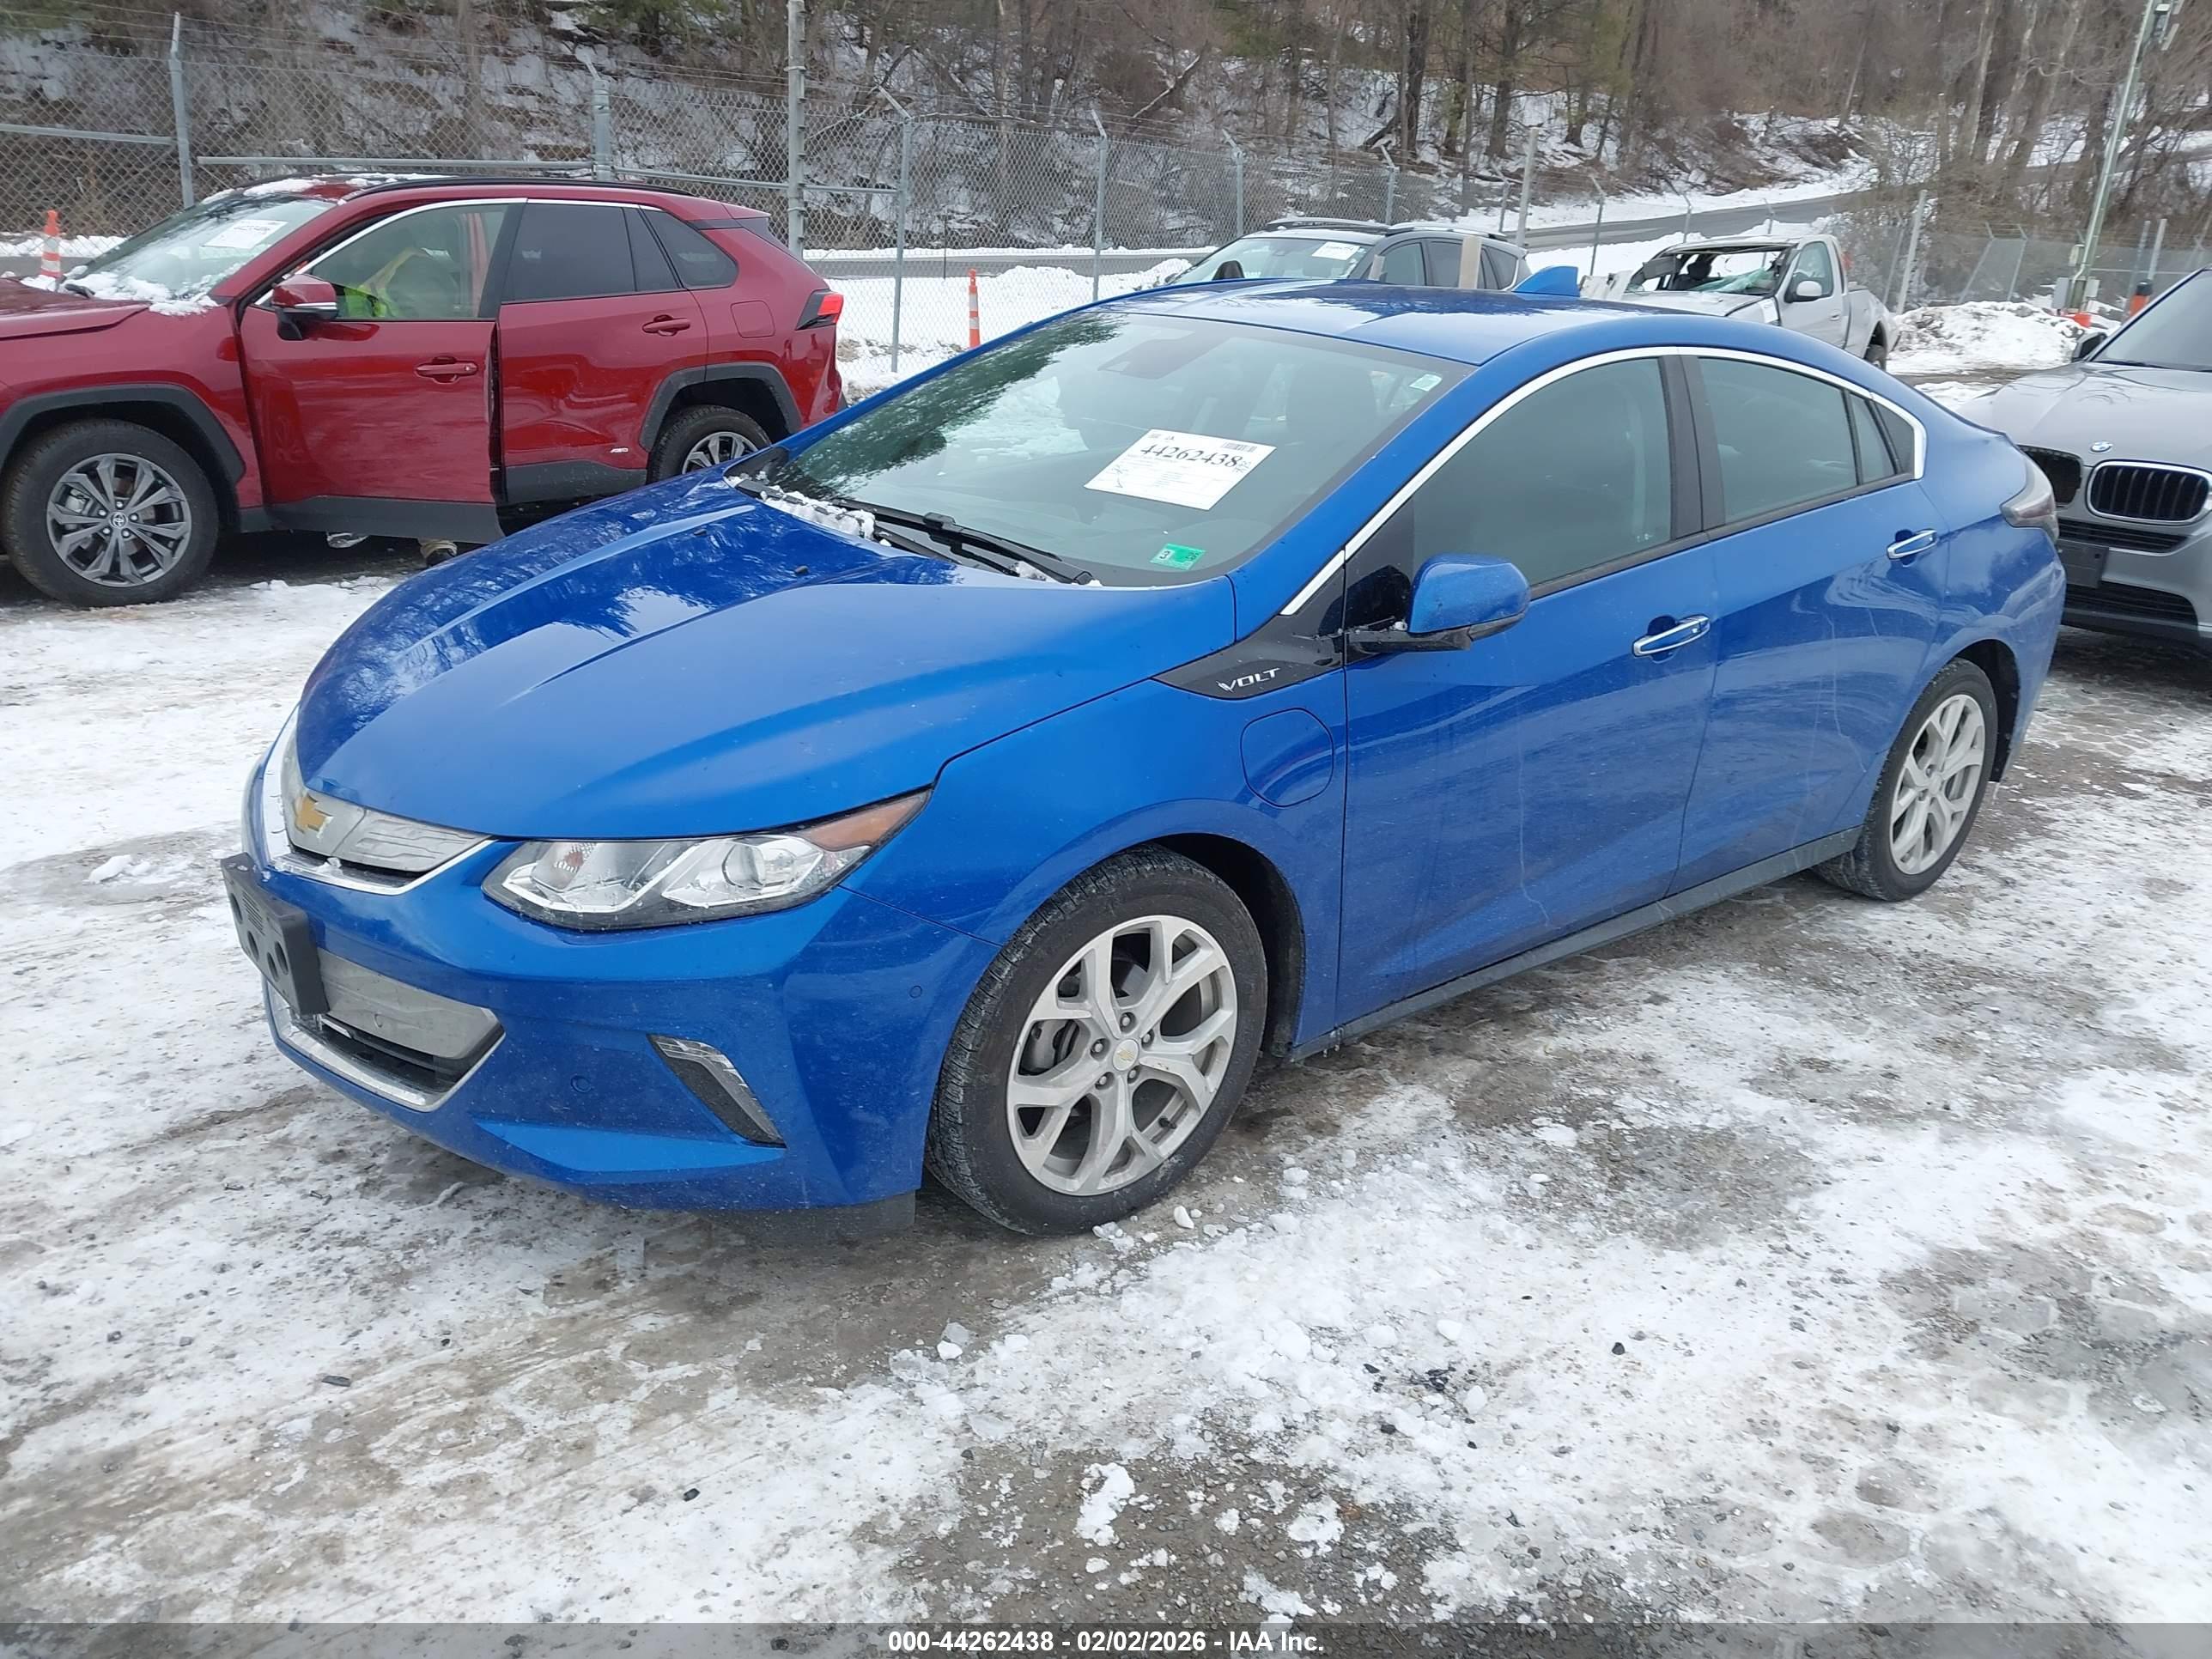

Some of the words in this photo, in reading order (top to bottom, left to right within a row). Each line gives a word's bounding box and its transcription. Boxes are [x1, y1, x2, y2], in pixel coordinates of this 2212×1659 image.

[1139, 443, 1243, 469] 44262438
[1159, 550, 1171, 560] 3
[1215, 667, 1281, 693] VOLT
